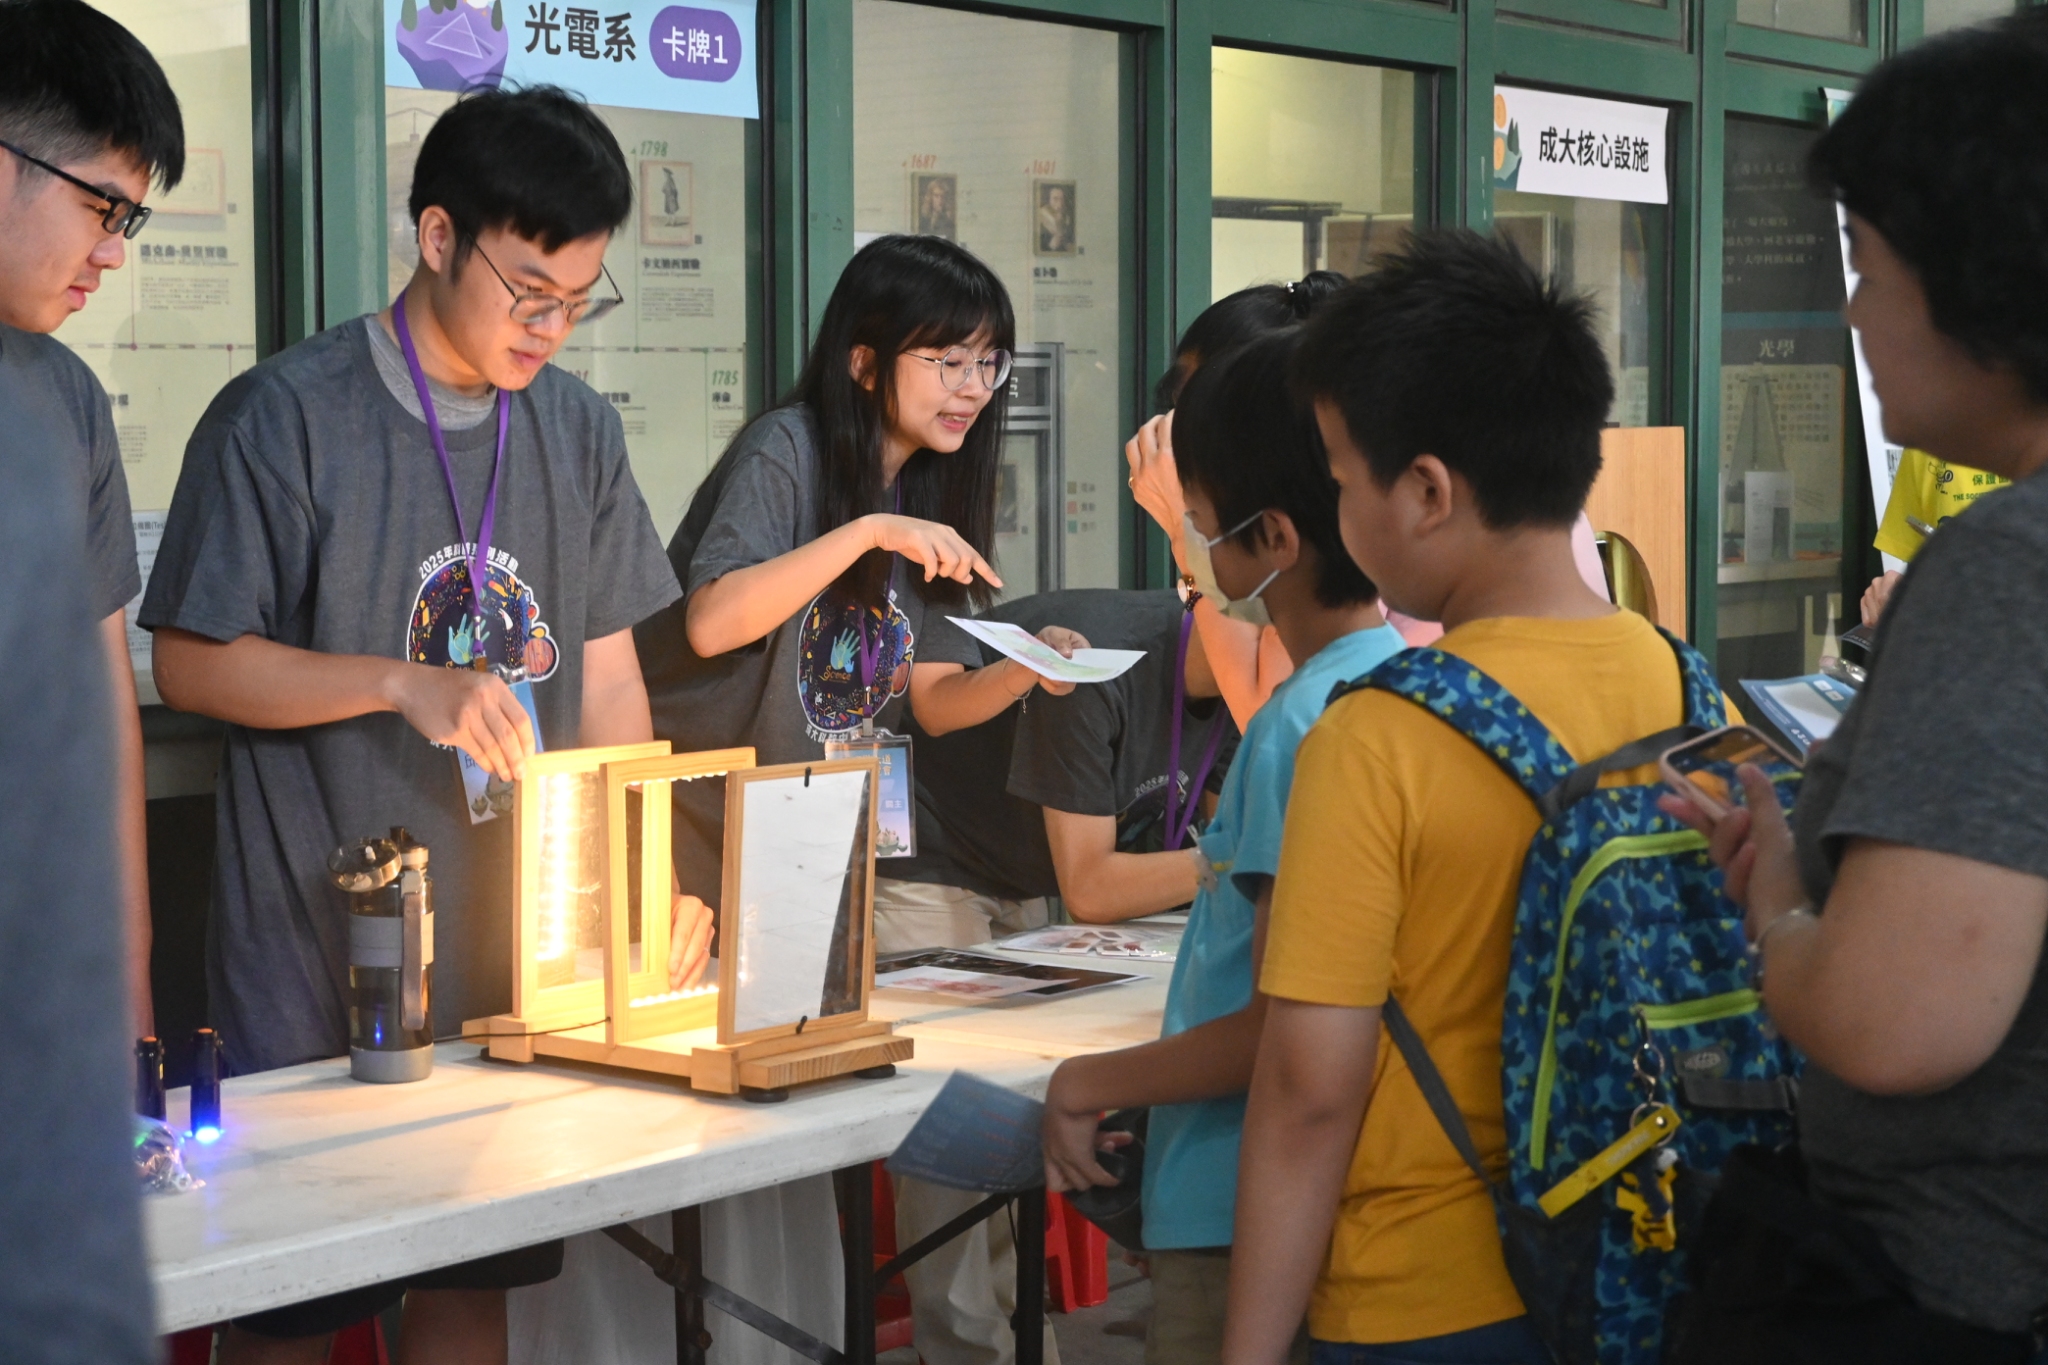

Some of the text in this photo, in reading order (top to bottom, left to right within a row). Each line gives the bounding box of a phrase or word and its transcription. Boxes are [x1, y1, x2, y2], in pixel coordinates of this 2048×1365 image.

[525, 2, 637, 63] 光電系
[662, 26, 729, 65] 卡牌1
[640, 141, 668, 157] 1798
[1538, 126, 1650, 173] 成大核心設施
[1760, 339, 1795, 358] 光學
[712, 370, 739, 386] 1785
[1953, 494, 1964, 502] THE
